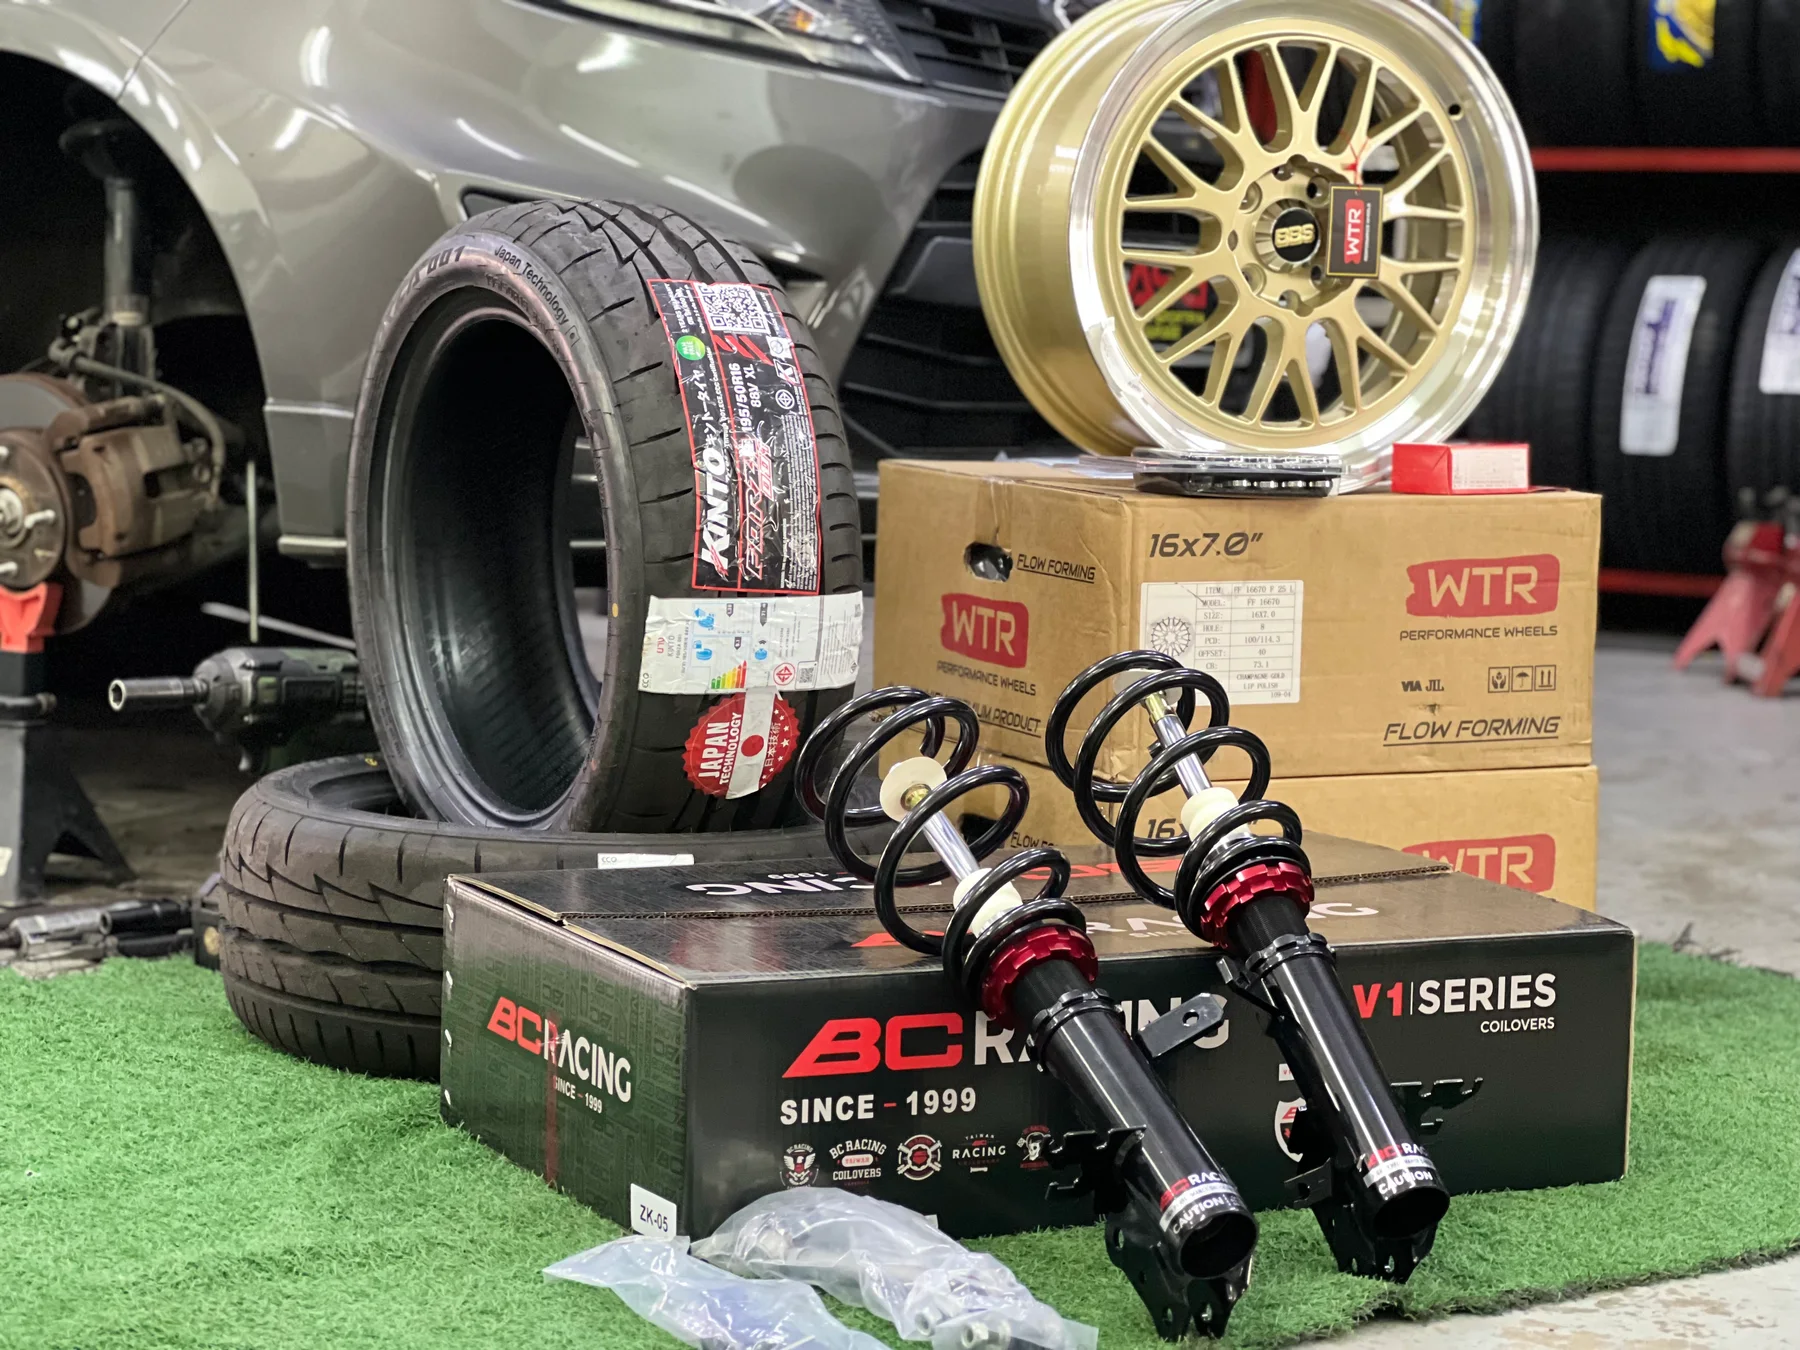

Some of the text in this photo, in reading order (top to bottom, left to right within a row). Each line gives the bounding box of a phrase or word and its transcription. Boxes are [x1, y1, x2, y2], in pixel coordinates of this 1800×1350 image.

[1274, 223, 1315, 248] BBS
[1346, 208, 1362, 255] WTR
[494, 245, 522, 270] Japan
[522, 262, 570, 326] Technology
[728, 362, 754, 432] 195/50R16
[743, 363, 762, 408] 88V XL
[701, 448, 730, 574] KINTO
[1016, 553, 1097, 581] FLOW FORMING
[1427, 565, 1538, 607] WTR
[1202, 599, 1226, 607] MODEL:
[1260, 598, 1280, 606] 16670
[952, 601, 1016, 657] WTR
[1204, 636, 1281, 645] PCD: 100/114.3
[1400, 625, 1558, 641] PERFORMANCE WHEELS
[667, 635, 676, 657] KINTO
[1198, 650, 1226, 658] OFFSET:
[937, 660, 1036, 696] PERFORMANCE WHEELS
[1206, 661, 1269, 670] CB: 73.1
[1401, 680, 1422, 692] VIA
[993, 709, 1041, 733] PRODUCT
[1384, 716, 1561, 741] FLOW FORMING
[698, 722, 730, 778] JAPAN
[719, 712, 742, 785] TECHNOLOGY
[764, 722, 781, 767] 日本技術
[1010, 831, 1040, 848] FLOW
[1352, 973, 1557, 1019] V1 SERIES
[1480, 1017, 1555, 1033] COILOVERS
[487, 996, 631, 1103] BC RACING
[781, 1012, 963, 1078] BC
[553, 1075, 577, 1100] SINCE
[585, 1092, 602, 1114] 1999
[780, 1095, 874, 1125] SINCE
[905, 1087, 976, 1116] 1999
[786, 1143, 814, 1155] BC RACING
[829, 1139, 887, 1159] BC RACING
[952, 1145, 1007, 1160] RACING
[832, 1168, 882, 1181] COILOVERS
[1379, 1171, 1434, 1194] CAUTION
[639, 1204, 668, 1233] ZK-05
[1173, 1196, 1225, 1234] CAUTION
